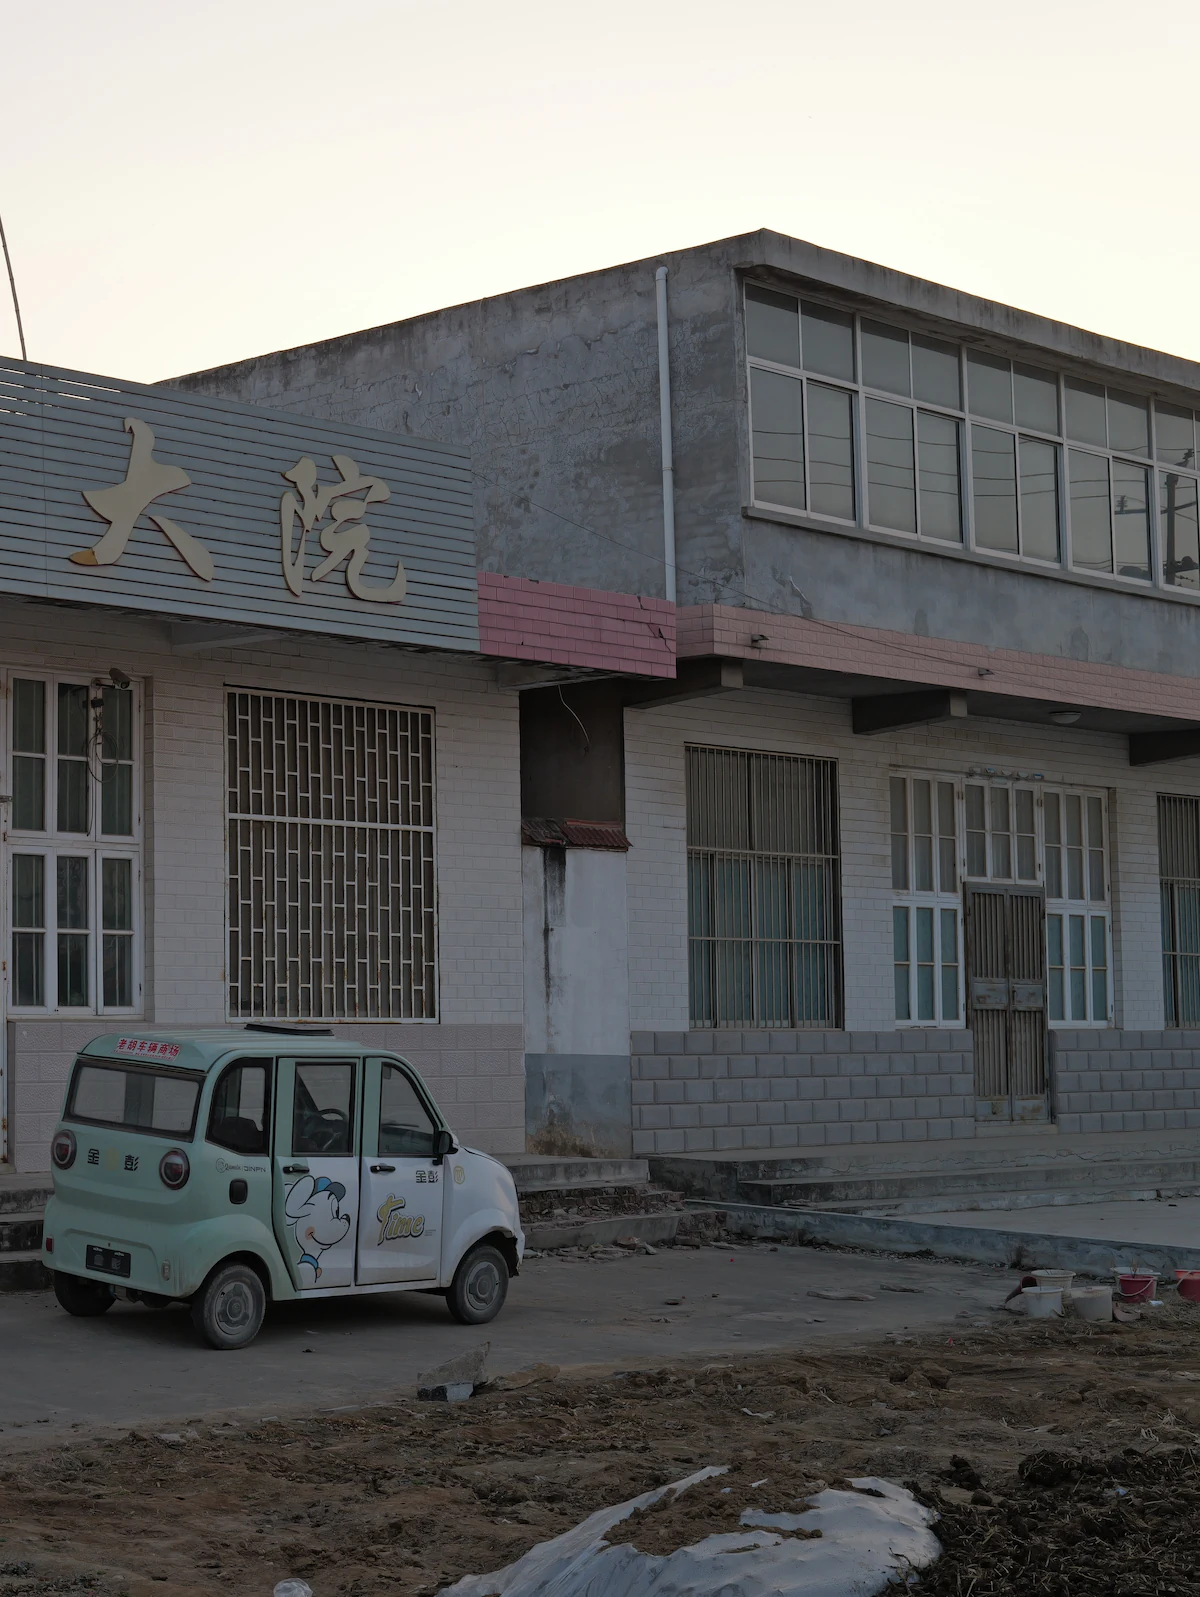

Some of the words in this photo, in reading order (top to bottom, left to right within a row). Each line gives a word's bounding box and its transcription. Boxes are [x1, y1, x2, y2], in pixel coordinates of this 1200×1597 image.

[117, 1039, 181, 1057] 老胡车辆商场
[87, 1148, 140, 1171] 金彭
[415, 1170, 439, 1184] 金彭
[376, 1193, 425, 1246] Time
